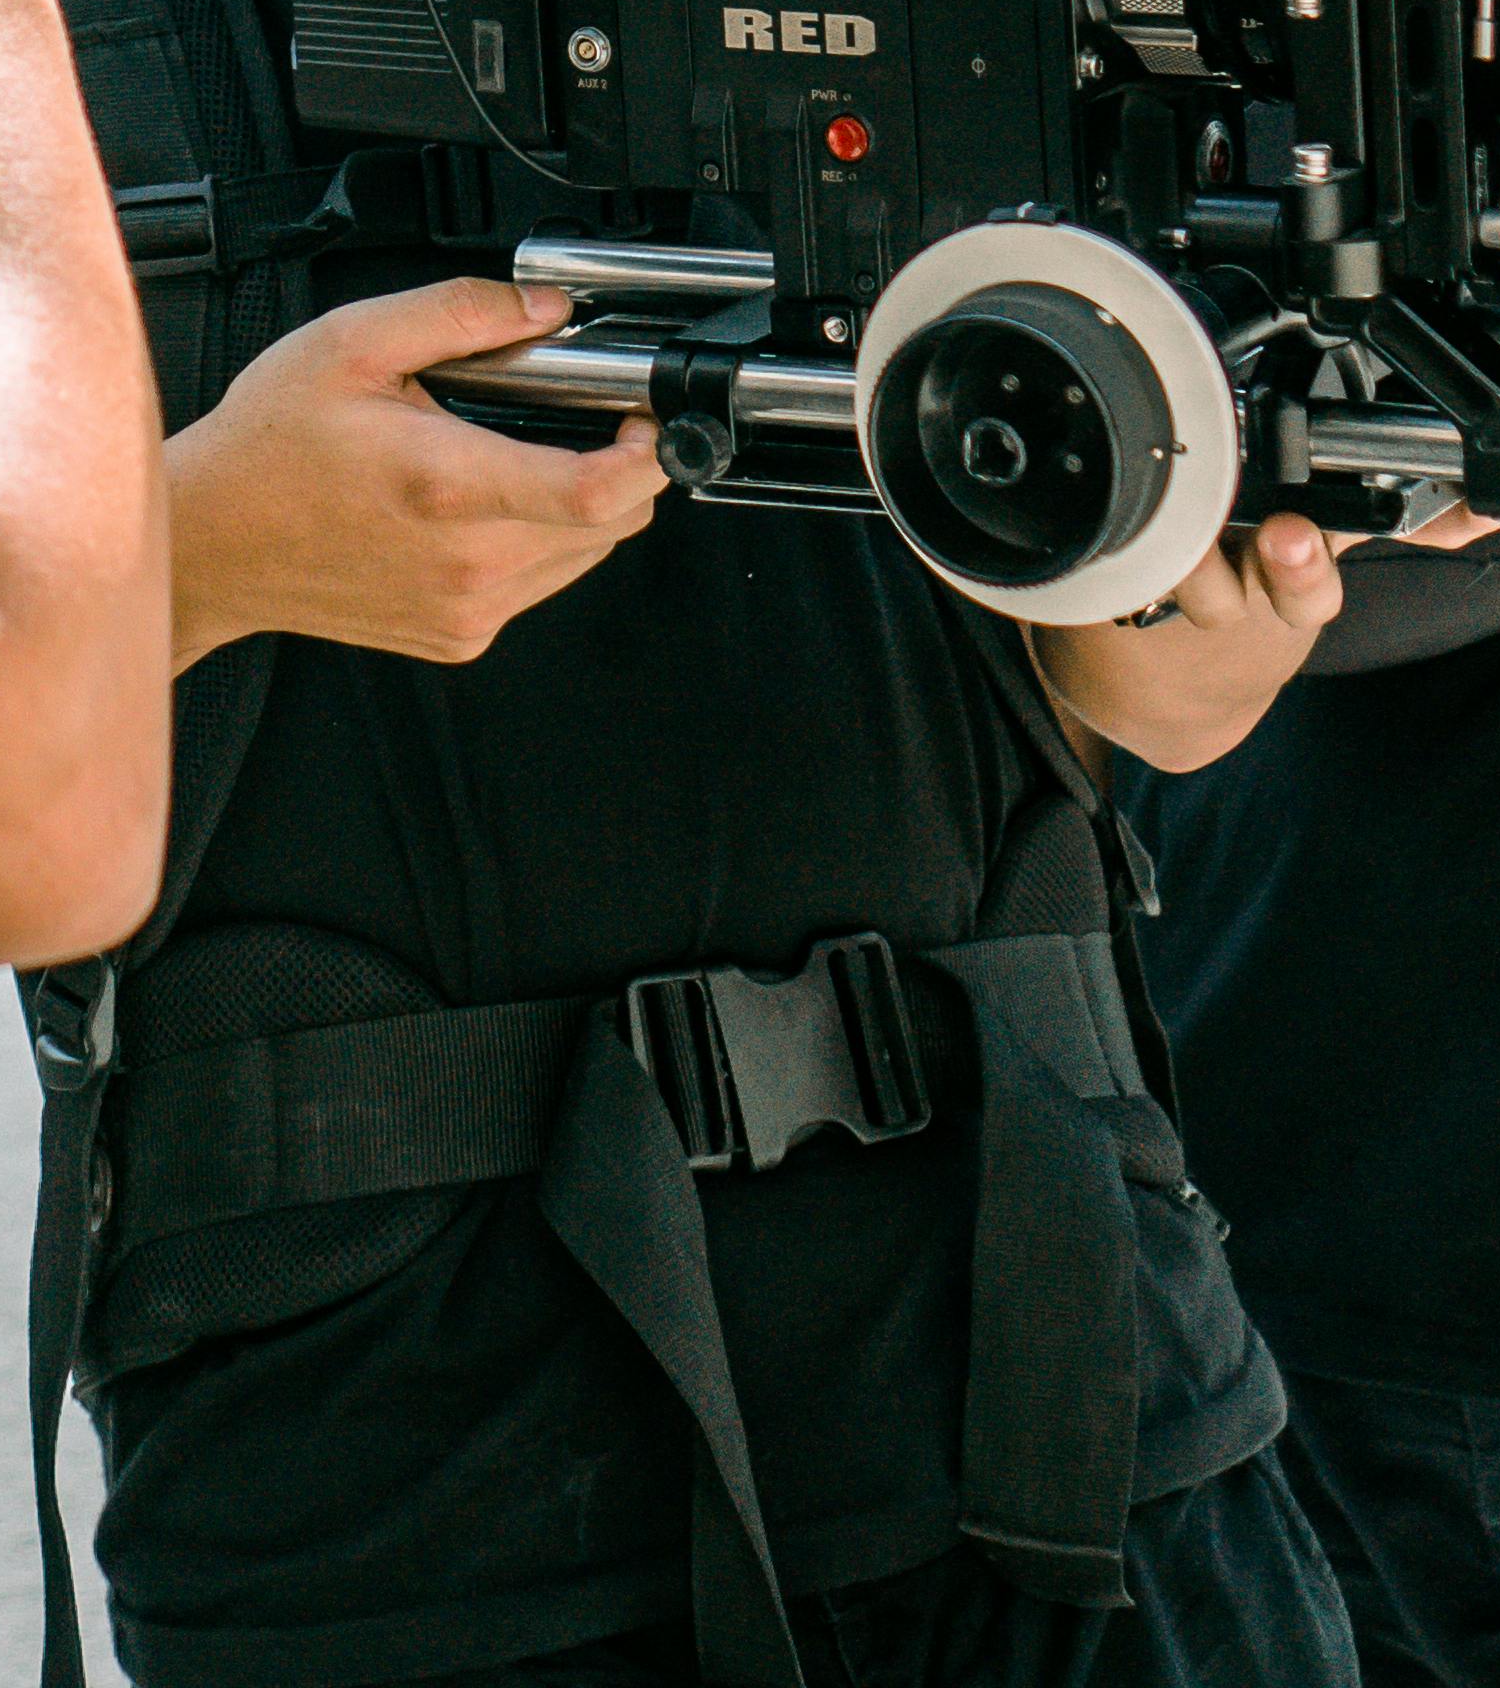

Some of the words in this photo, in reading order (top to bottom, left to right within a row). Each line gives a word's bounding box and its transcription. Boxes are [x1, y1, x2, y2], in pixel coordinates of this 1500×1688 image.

[723, 7, 877, 56] RED
[577, 77, 599, 89] AUX
[600, 78, 608, 90] 2
[811, 88, 838, 102] PWR
[822, 169, 844, 183] REC
